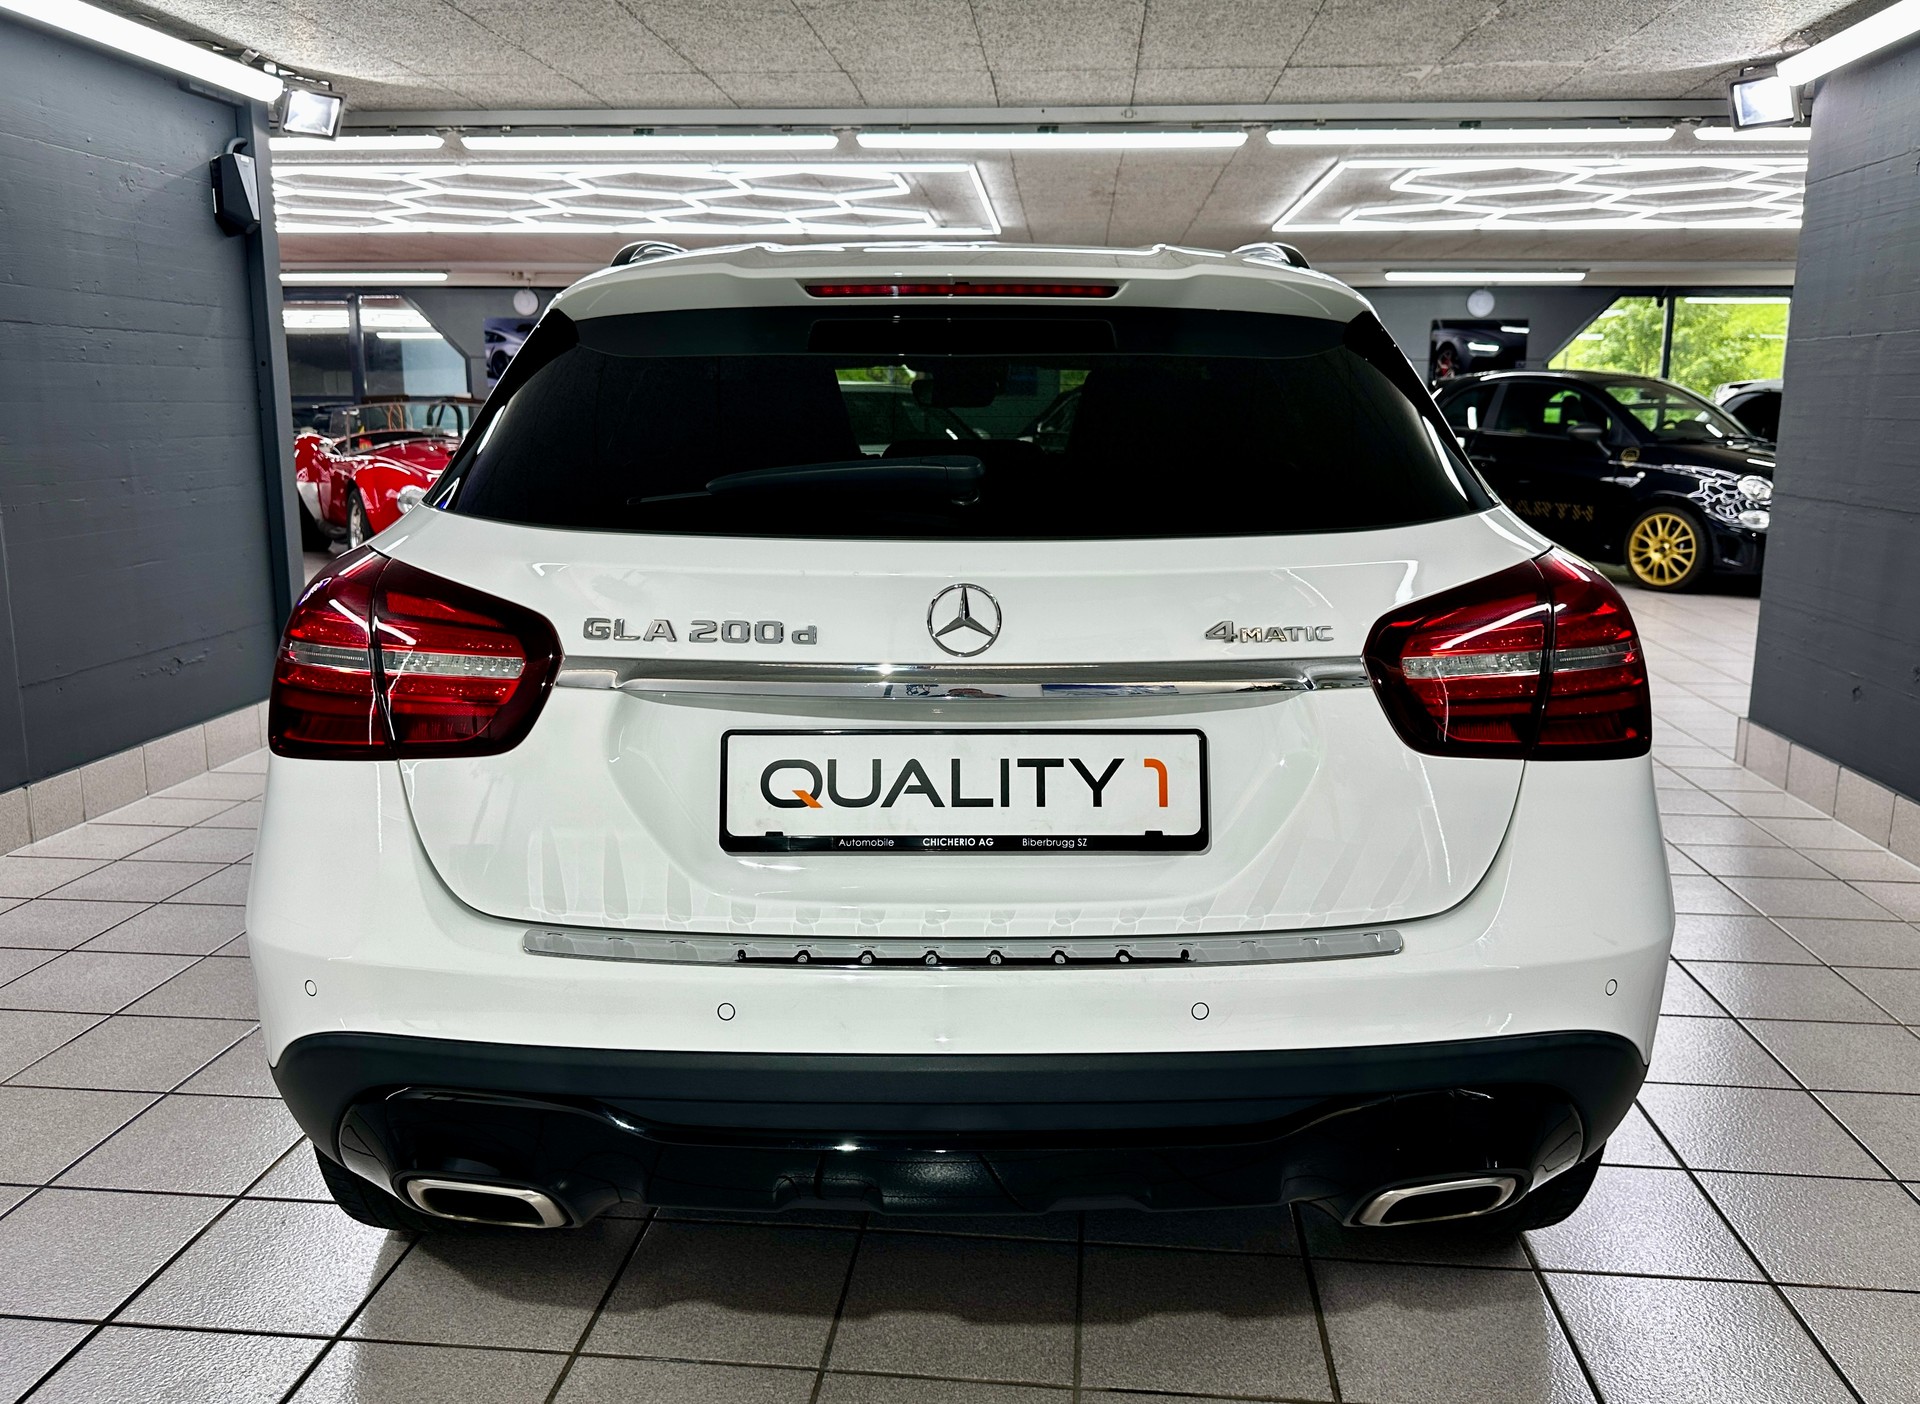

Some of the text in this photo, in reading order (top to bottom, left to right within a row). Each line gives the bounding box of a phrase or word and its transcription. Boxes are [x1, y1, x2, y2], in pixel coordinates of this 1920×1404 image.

[583, 617, 678, 643] GLA
[1205, 620, 1335, 644] 4MATIC
[760, 757, 1169, 809] QUALITY 1
[838, 837, 1088, 849] Automobile CHICHERIO AG Biberbrugg SZ
